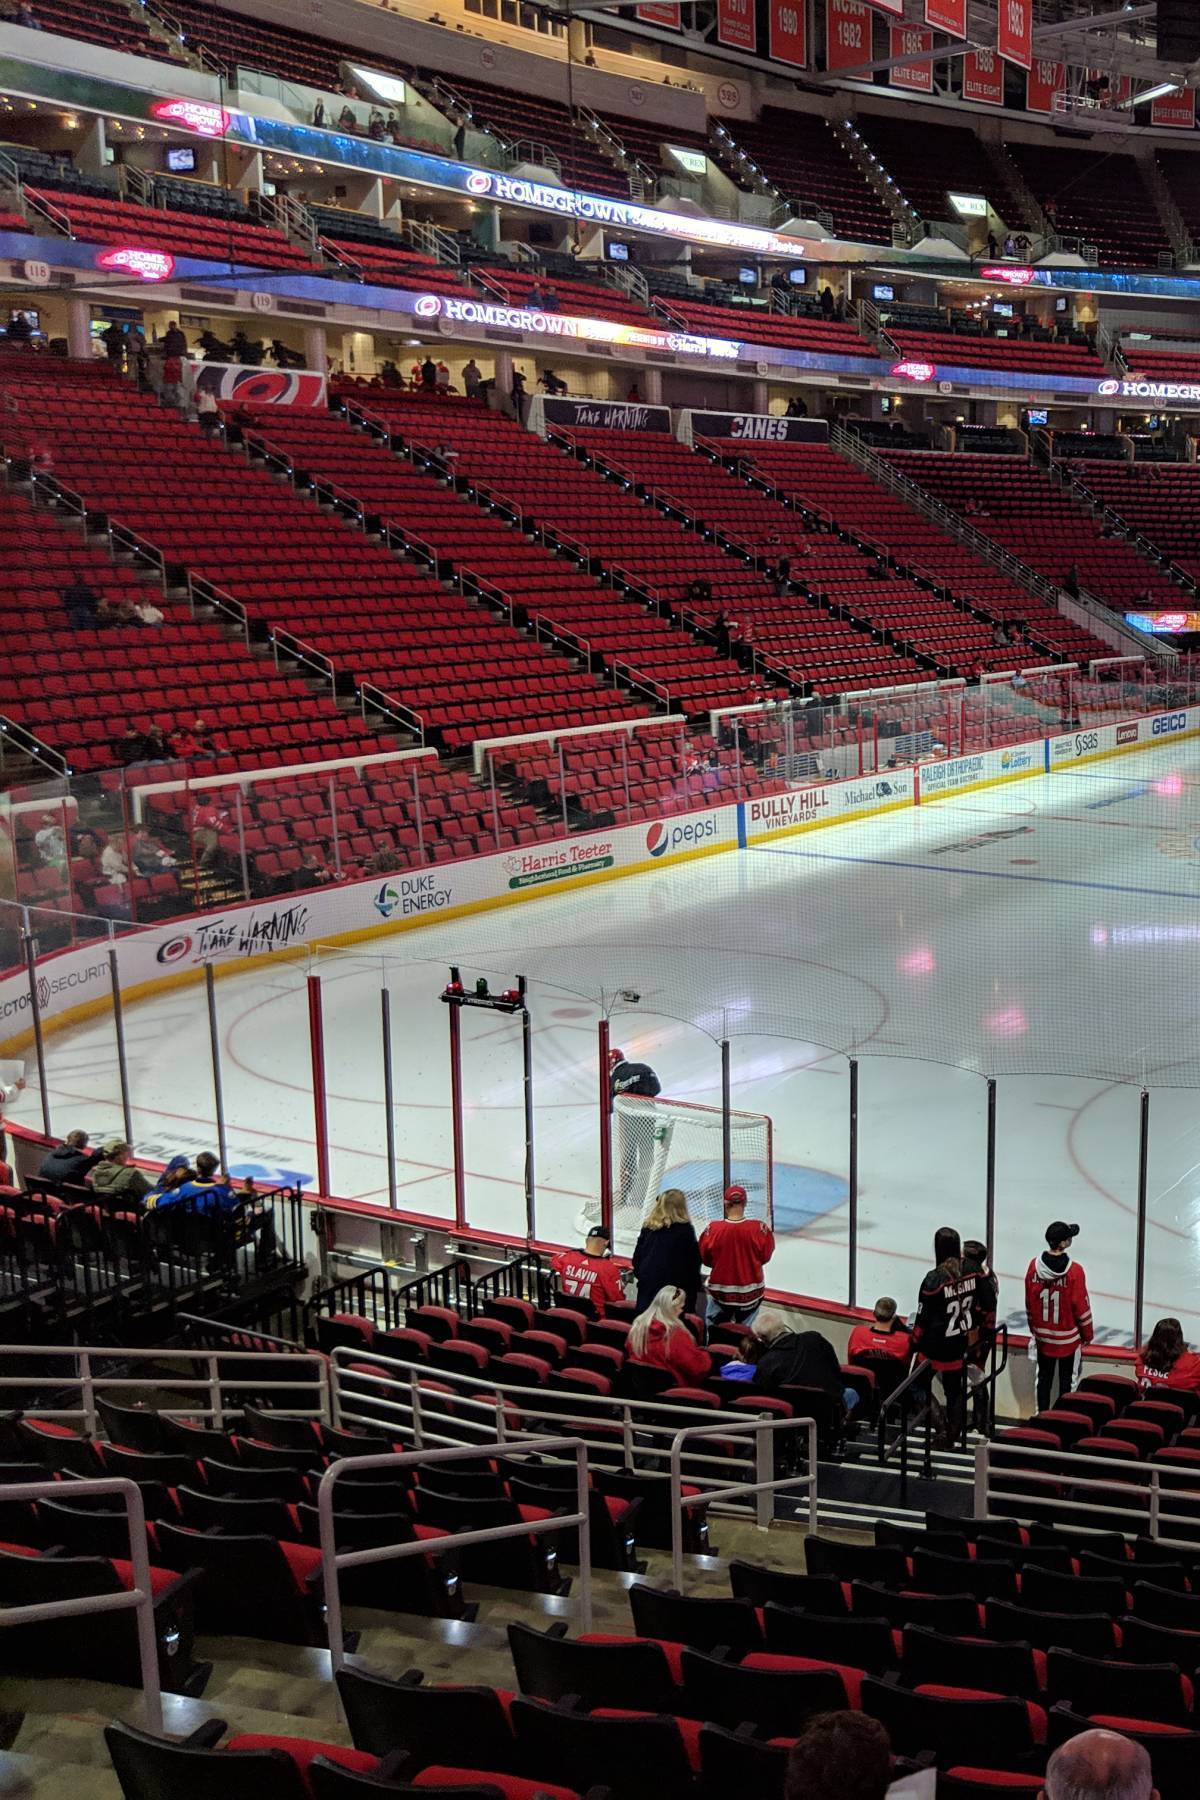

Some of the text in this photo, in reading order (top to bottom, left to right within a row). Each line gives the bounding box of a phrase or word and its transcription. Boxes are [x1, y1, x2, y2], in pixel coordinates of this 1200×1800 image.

[777, 5, 798, 36] 1980
[832, 0, 866, 17] NCAA
[837, 20, 862, 48] 1982
[911, 70, 929, 83] EIGHT
[966, 81, 1001, 96] ELITE EIGHT
[495, 174, 629, 225] HOMEGROWN
[30, 265, 47, 277] 118
[445, 296, 579, 337] HOMEGROWN
[574, 403, 649, 432] TAKE WARNING
[730, 416, 789, 441] CANES
[1117, 727, 1137, 741] Lenovo
[1152, 712, 1186, 735] GEICO
[1082, 732, 1099, 750] sas
[921, 756, 984, 784] RALEIGH ORTHOPAEDIC
[1010, 755, 1032, 769] Lottery
[751, 788, 829, 822] BULLY HILL
[844, 781, 907, 806] Michael Son
[672, 814, 718, 849] pepsi
[765, 808, 817, 830] VINEYARDS
[521, 843, 613, 873] Harris Teeter
[402, 875, 436, 896] DUKE
[402, 888, 453, 915] ENERGY
[196, 903, 313, 957] TAKE WARNING
[50, 960, 113, 994] SECURITY
[565, 1264, 598, 1283] SLAVIN
[945, 1295, 974, 1338] 23
[1039, 1288, 1060, 1324] 11
